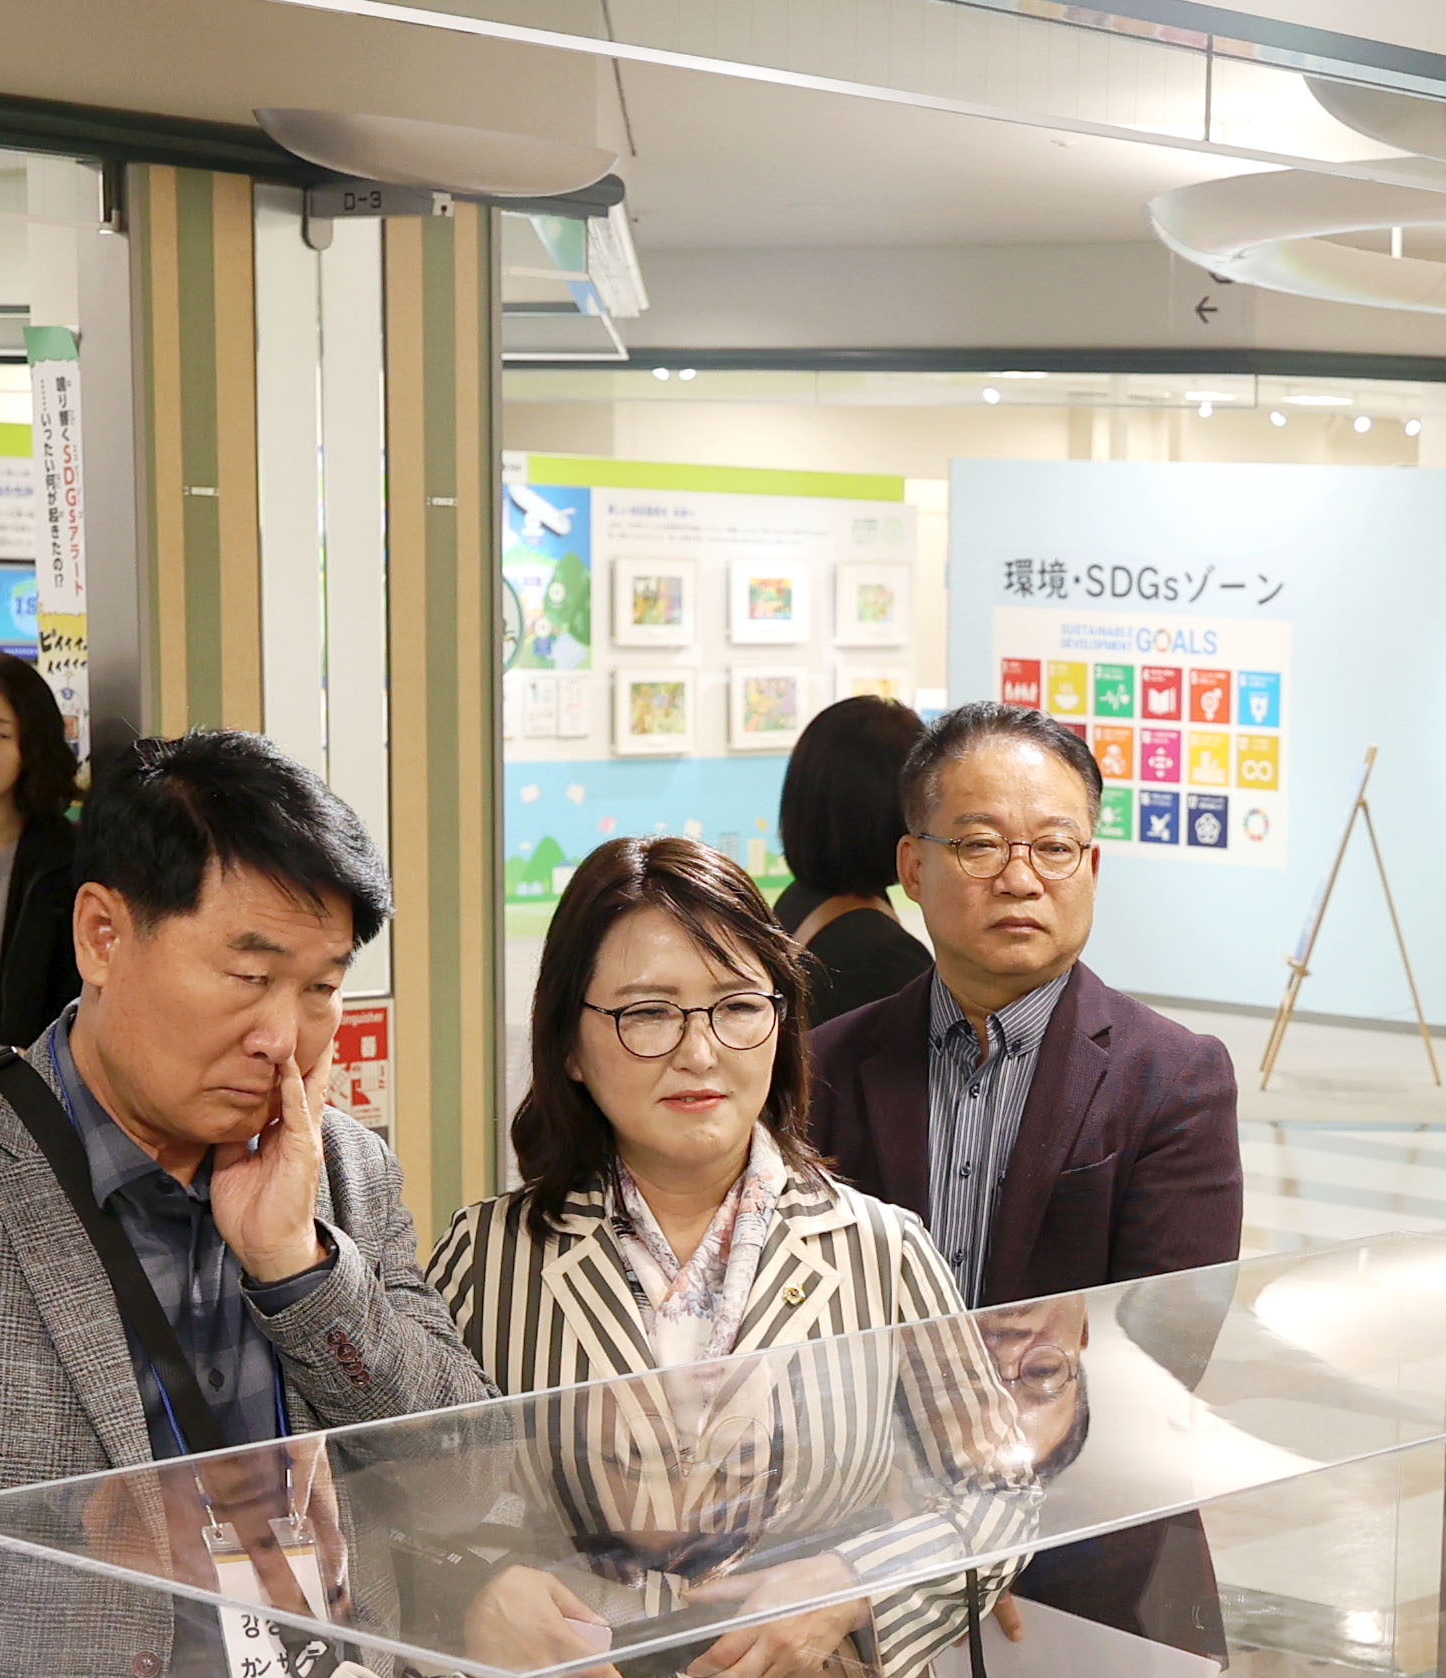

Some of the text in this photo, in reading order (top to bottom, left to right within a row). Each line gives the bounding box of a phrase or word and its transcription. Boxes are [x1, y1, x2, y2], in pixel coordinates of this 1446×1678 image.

[1004, 558, 1284, 605] 環境・SDGsゾーン
[1136, 626, 1219, 656] GOALS
